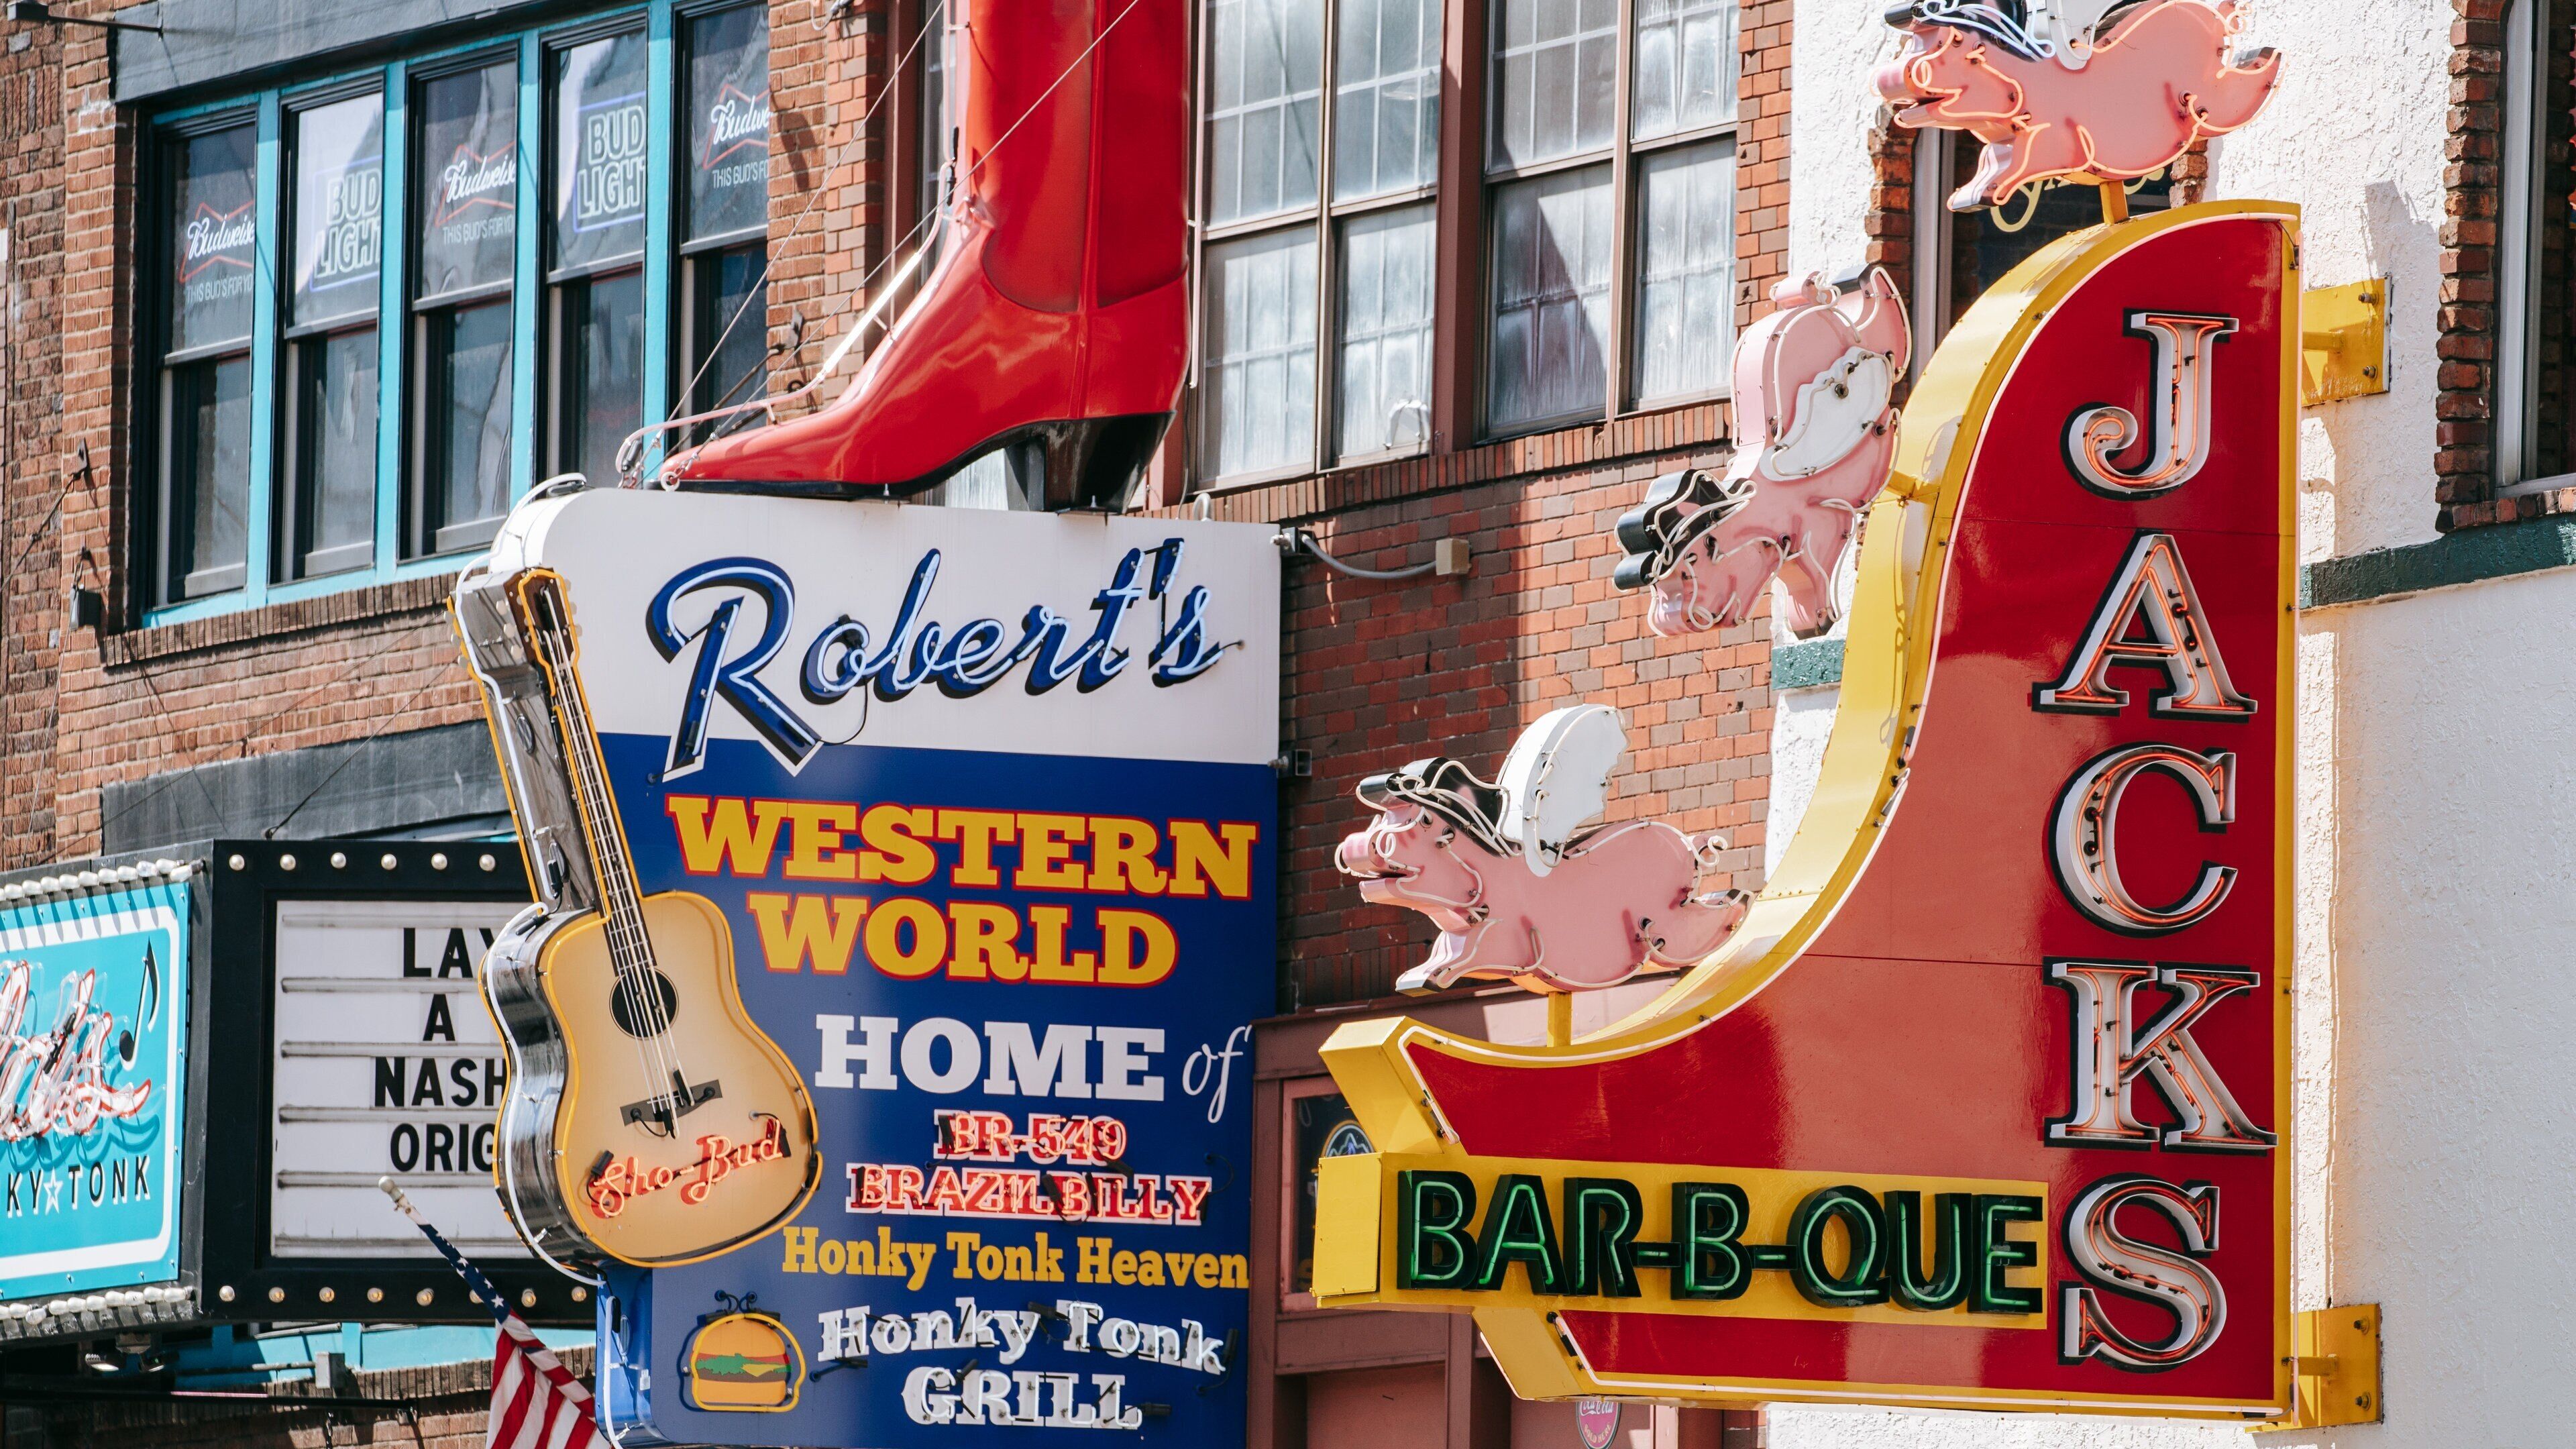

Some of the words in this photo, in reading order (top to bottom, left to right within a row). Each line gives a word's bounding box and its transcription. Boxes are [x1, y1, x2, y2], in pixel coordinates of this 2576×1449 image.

[588, 105, 645, 165] BUD
[327, 167, 380, 225] BUD
[712, 167, 731, 189] THIS
[443, 223, 462, 244] THIS
[186, 282, 203, 303] THIS
[646, 538, 1228, 782] Robert's
[665, 794, 1260, 901] WESTERN
[2033, 309, 2279, 1373] JACKS
[746, 892, 1179, 987] WORLD
[423, 994, 455, 1041] A
[375, 1057, 506, 1107] NASH
[815, 1014, 1165, 1102] HOME
[1183, 1024, 1252, 1124] of
[390, 1123, 494, 1172] ORIG
[589, 1118, 784, 1219] Sho-Bud
[933, 1109, 1128, 1166] BR-549
[68, 1155, 151, 1210] TONK
[782, 1226, 937, 1291] Honky
[947, 1232, 1065, 1283] Tonk
[1077, 1237, 1250, 1289] Heaven
[1397, 1170, 2043, 1315] BAR-B-QUE
[818, 1297, 1041, 1364] Honky
[1057, 1299, 1227, 1374] Tonk
[901, 1366, 1142, 1430] GRILL
